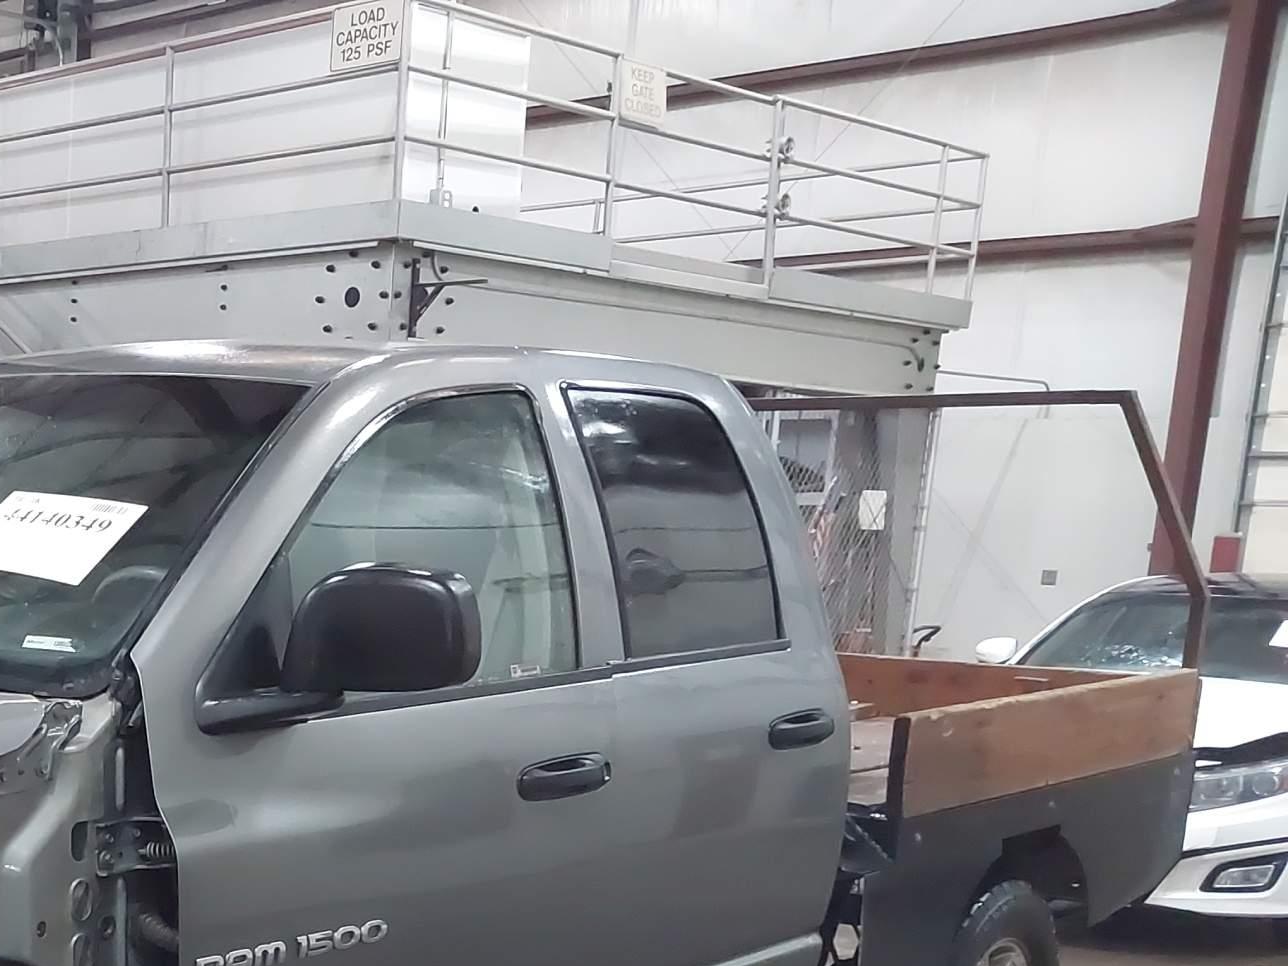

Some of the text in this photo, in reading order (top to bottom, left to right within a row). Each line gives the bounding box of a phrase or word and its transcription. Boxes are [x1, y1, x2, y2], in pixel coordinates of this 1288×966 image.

[351, 7, 385, 27] LOAD
[336, 20, 399, 46] CAPACITY
[340, 40, 392, 63] 125 PSF
[632, 64, 655, 83] KEEP
[632, 83, 654, 101] GATE
[624, 97, 662, 118] CLOSED
[296, 919, 388, 958] 1500
